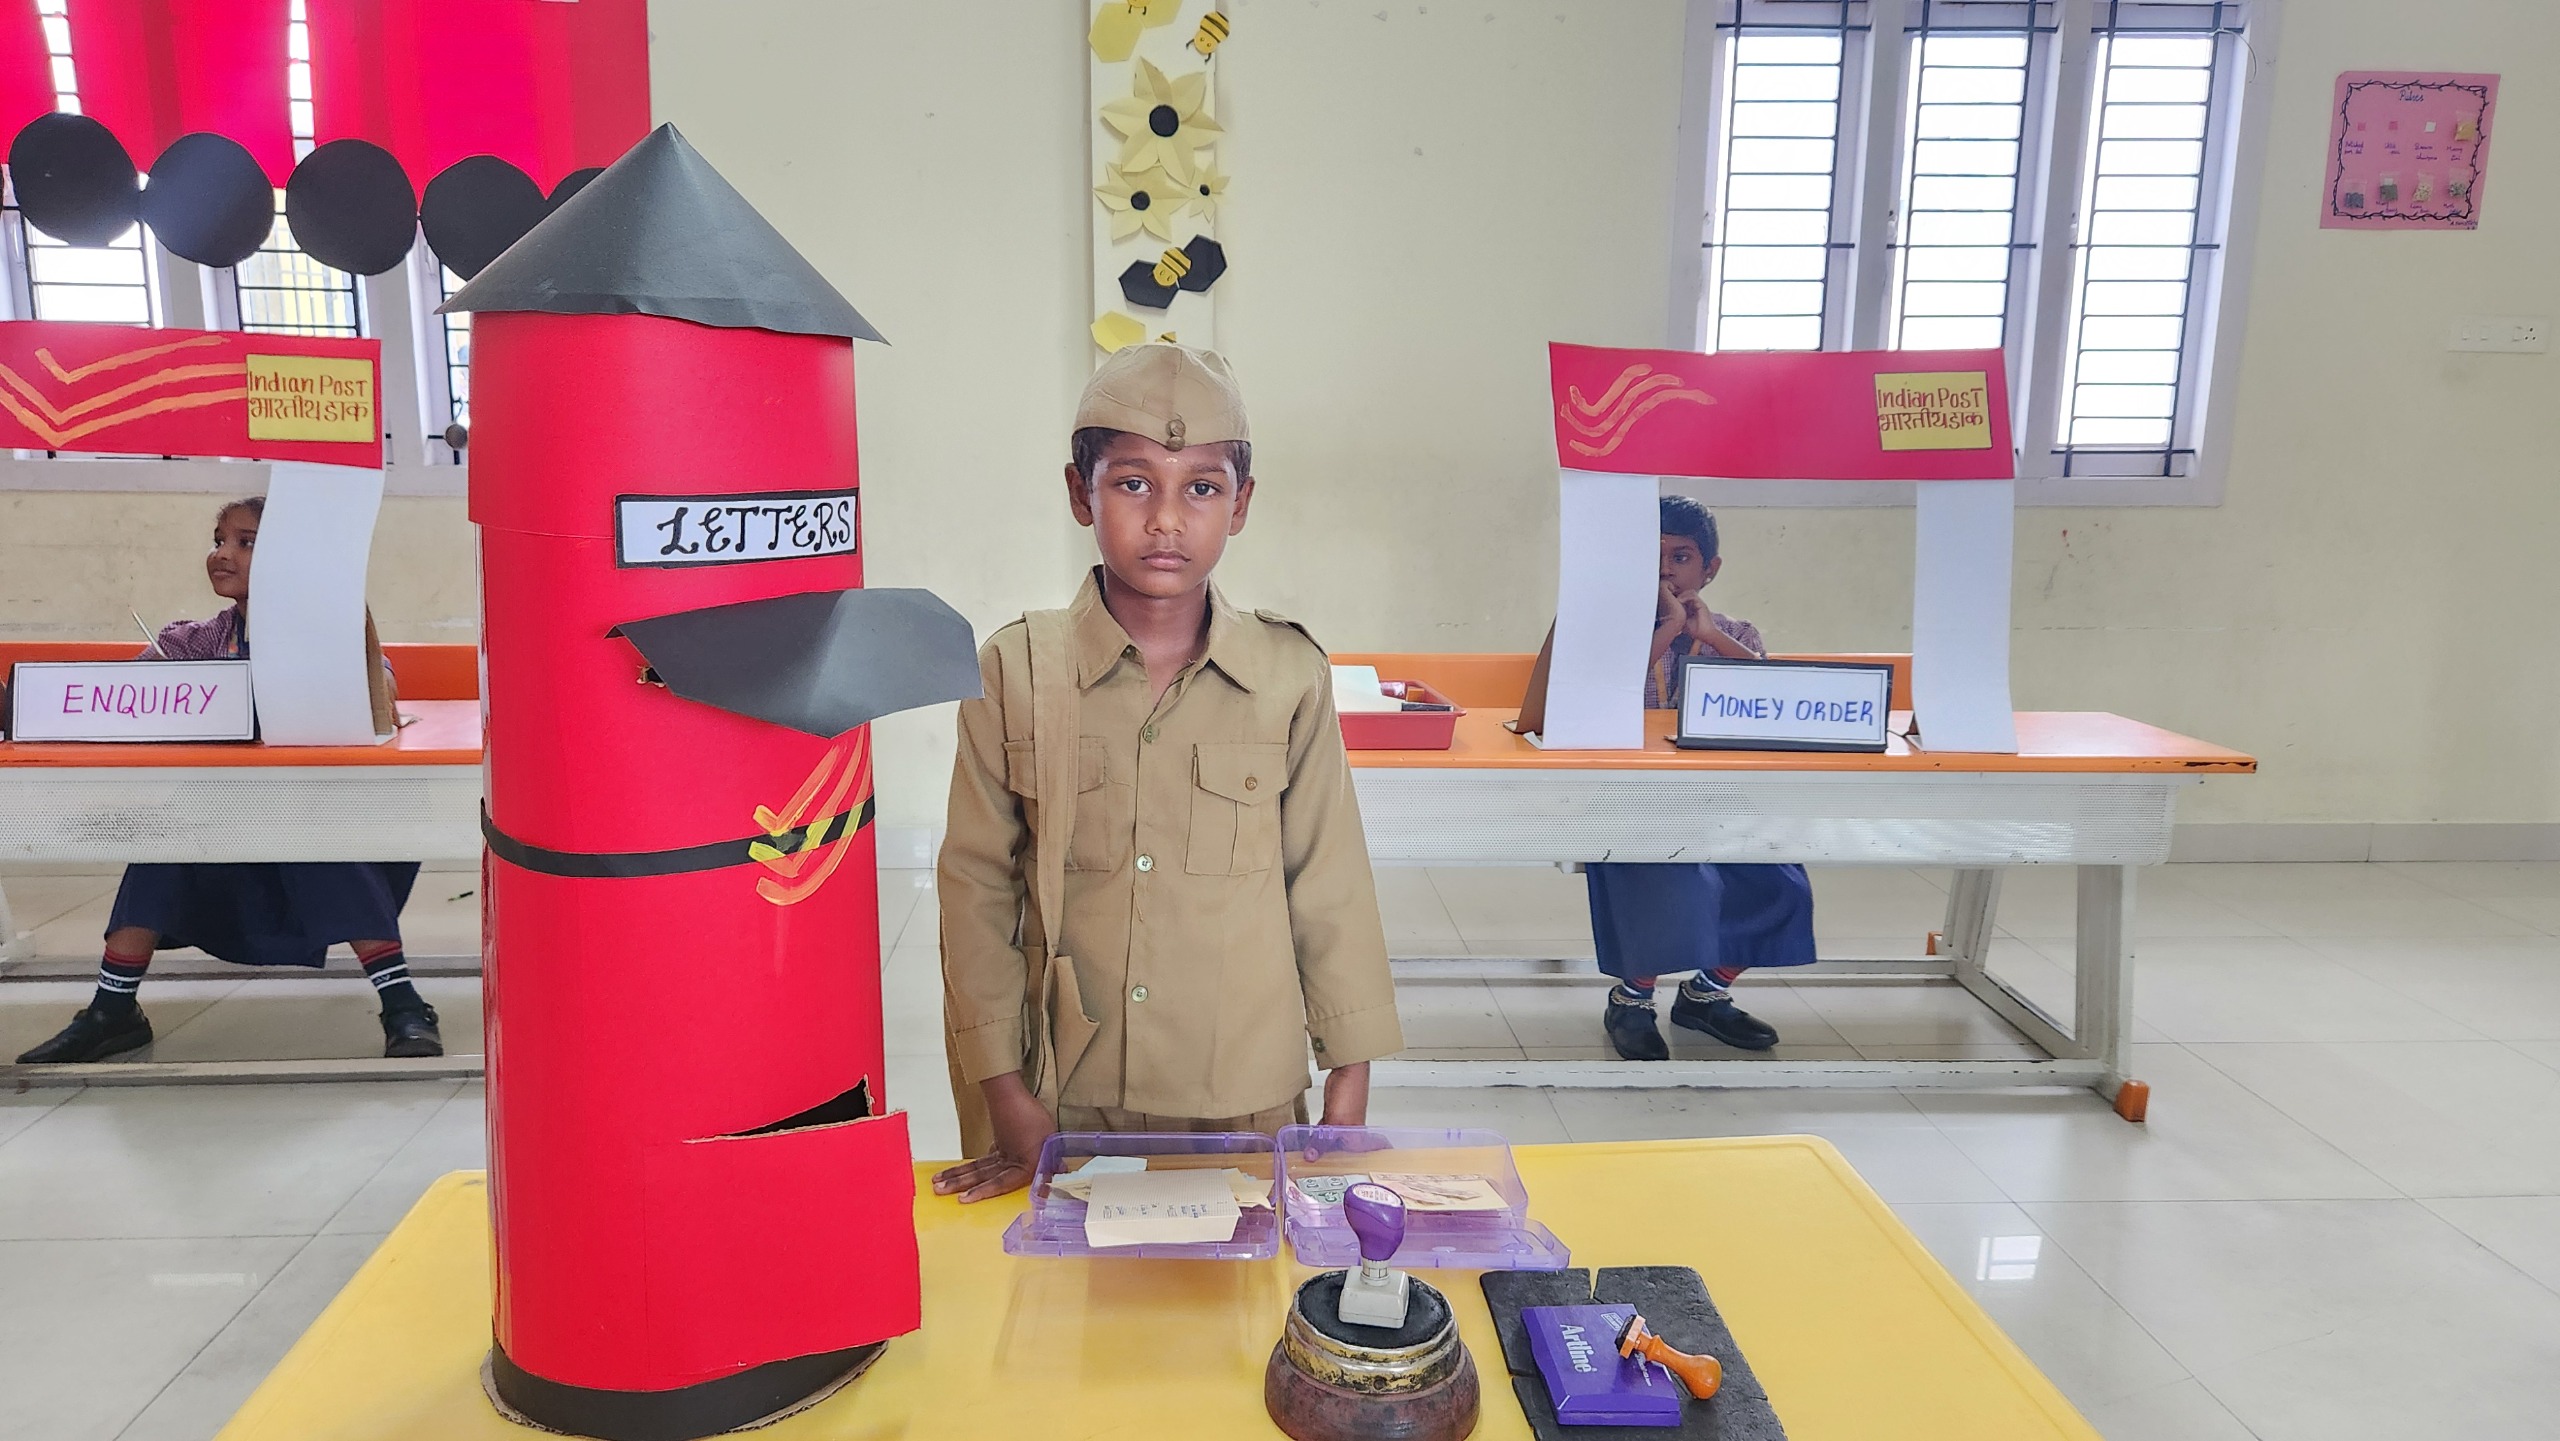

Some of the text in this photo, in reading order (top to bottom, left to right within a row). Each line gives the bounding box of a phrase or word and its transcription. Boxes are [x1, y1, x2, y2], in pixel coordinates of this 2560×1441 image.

[250, 371, 314, 394] Indian
[1878, 388, 1935, 408] Indian
[656, 500, 851, 555] LETTERS
[63, 682, 218, 718] ENQUIRY
[1701, 692, 1873, 726] MONEY ORDER
[1560, 1324, 1598, 1373] Artline
